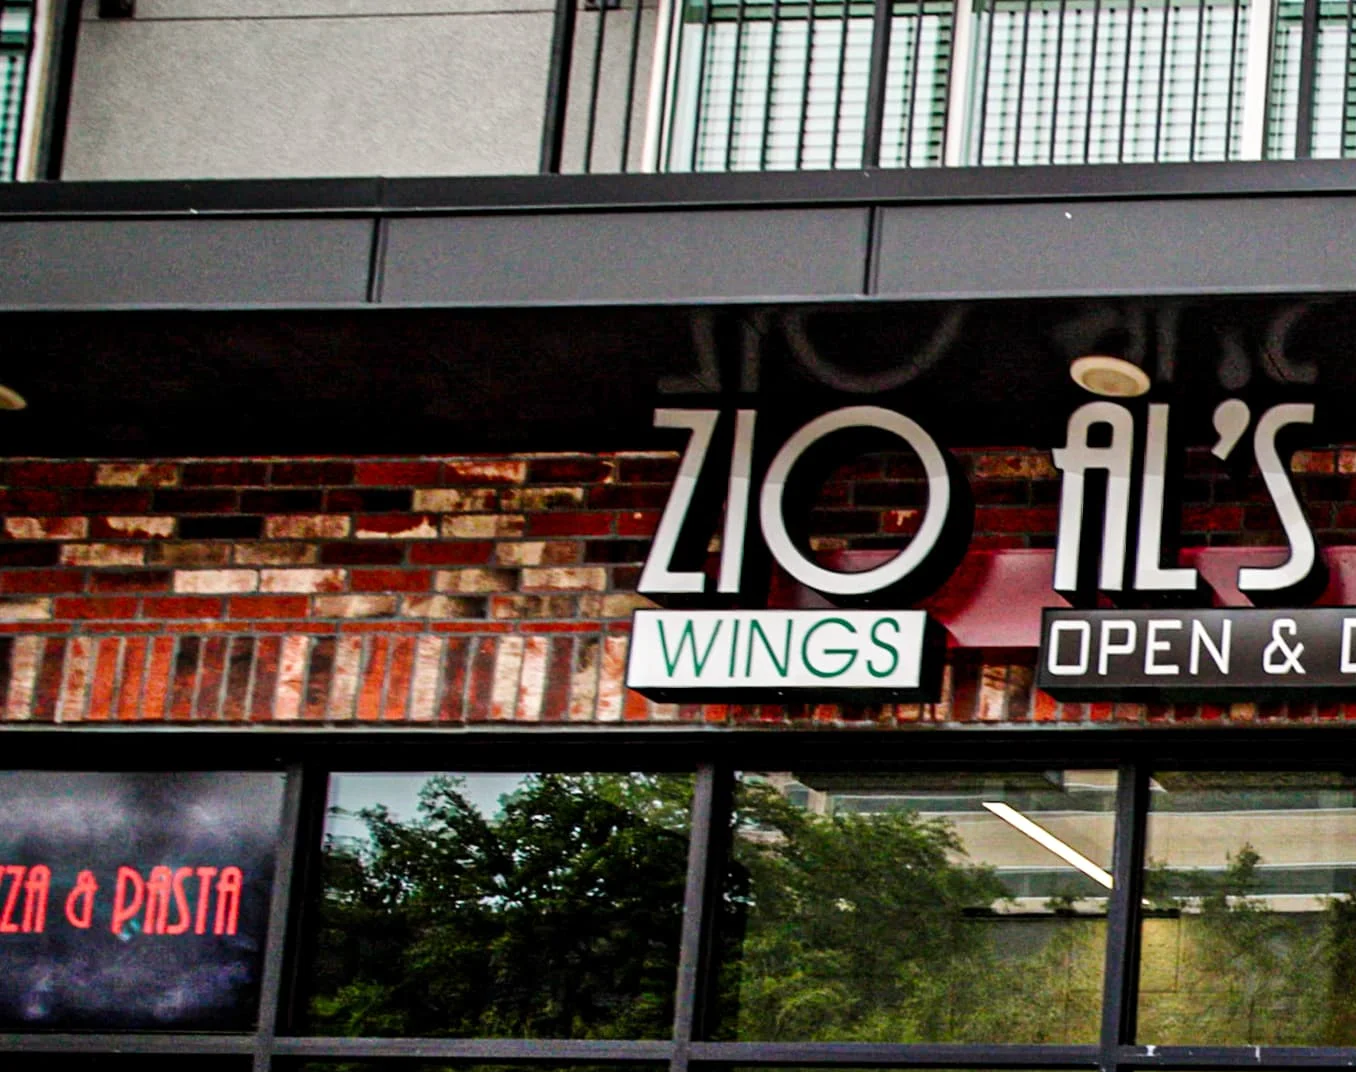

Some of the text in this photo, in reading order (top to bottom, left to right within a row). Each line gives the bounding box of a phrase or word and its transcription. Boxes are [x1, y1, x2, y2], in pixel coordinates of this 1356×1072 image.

[636, 406, 951, 596] ZIO
[1050, 397, 1316, 593] AL'S
[656, 617, 901, 679] WINGS
[1046, 618, 1232, 677] OPEN
[1262, 616, 1307, 675] &
[64, 868, 99, 930] &
[111, 865, 244, 937] PASTA
